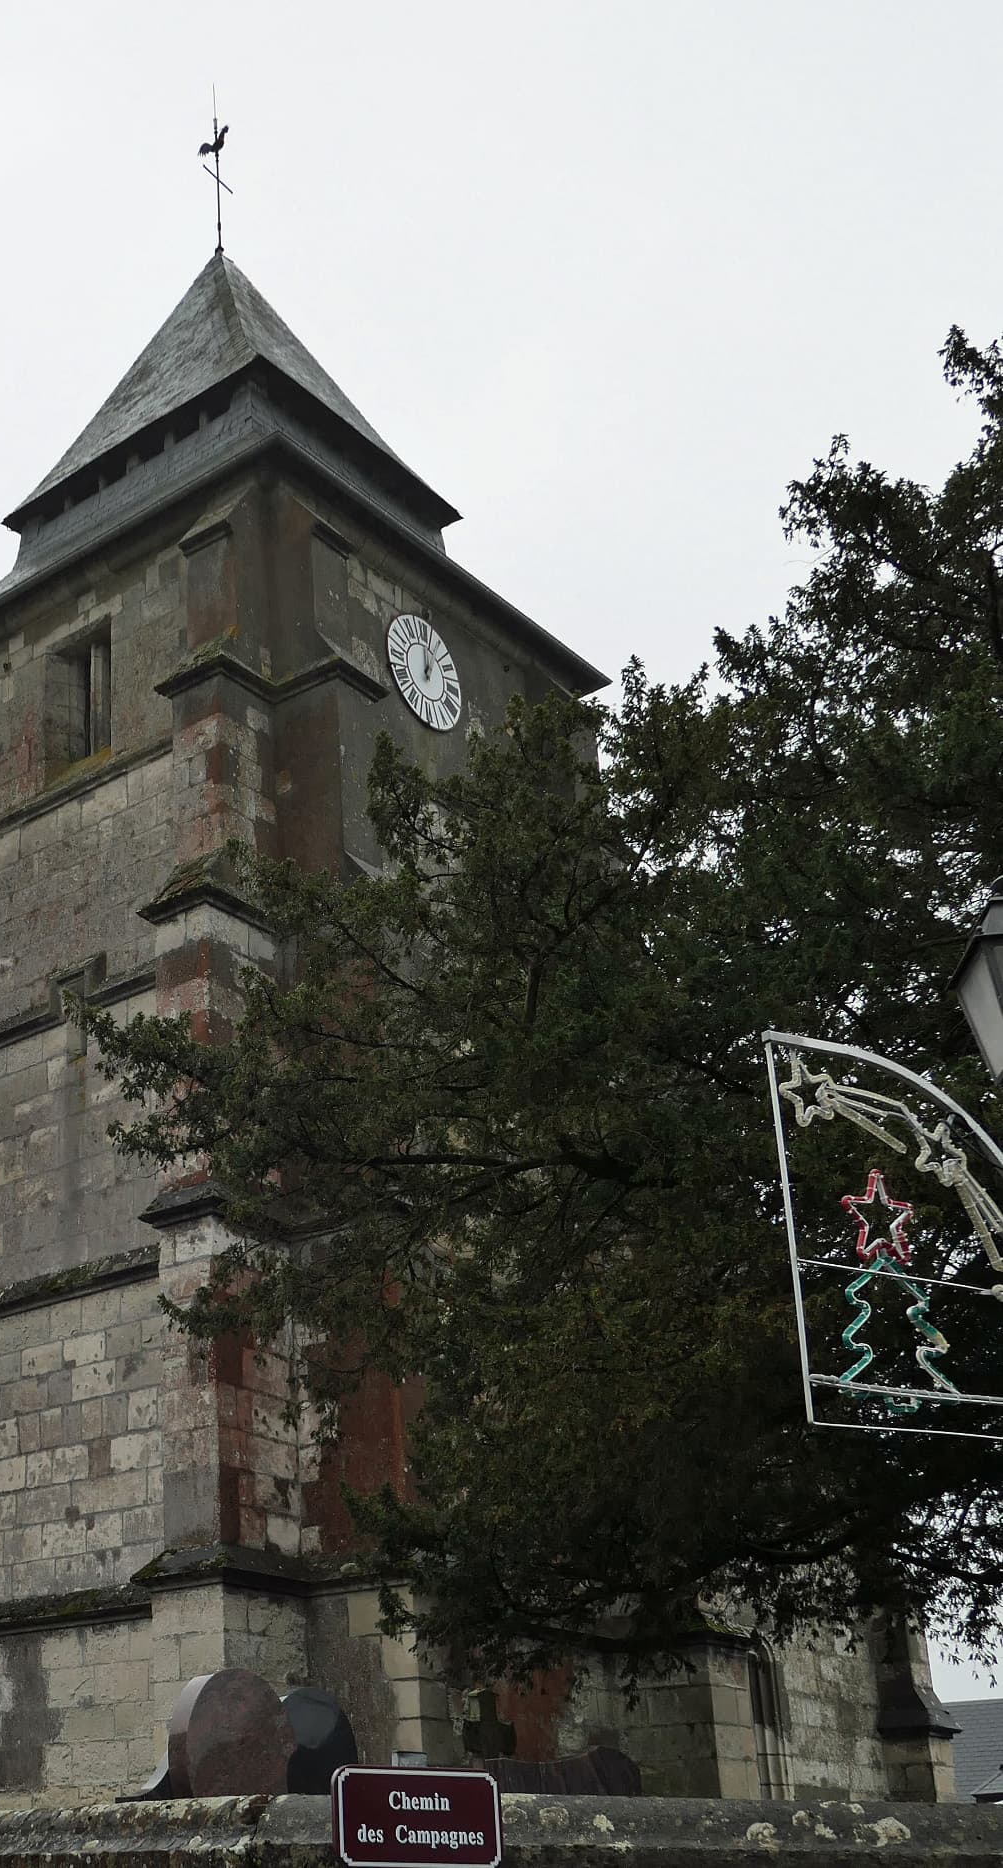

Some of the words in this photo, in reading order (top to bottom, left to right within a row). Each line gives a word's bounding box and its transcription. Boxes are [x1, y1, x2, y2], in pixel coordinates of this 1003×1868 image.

[388, 1790, 451, 1812] Chemin
[357, 1823, 384, 1844] des
[395, 1824, 485, 1850] Campagnes
